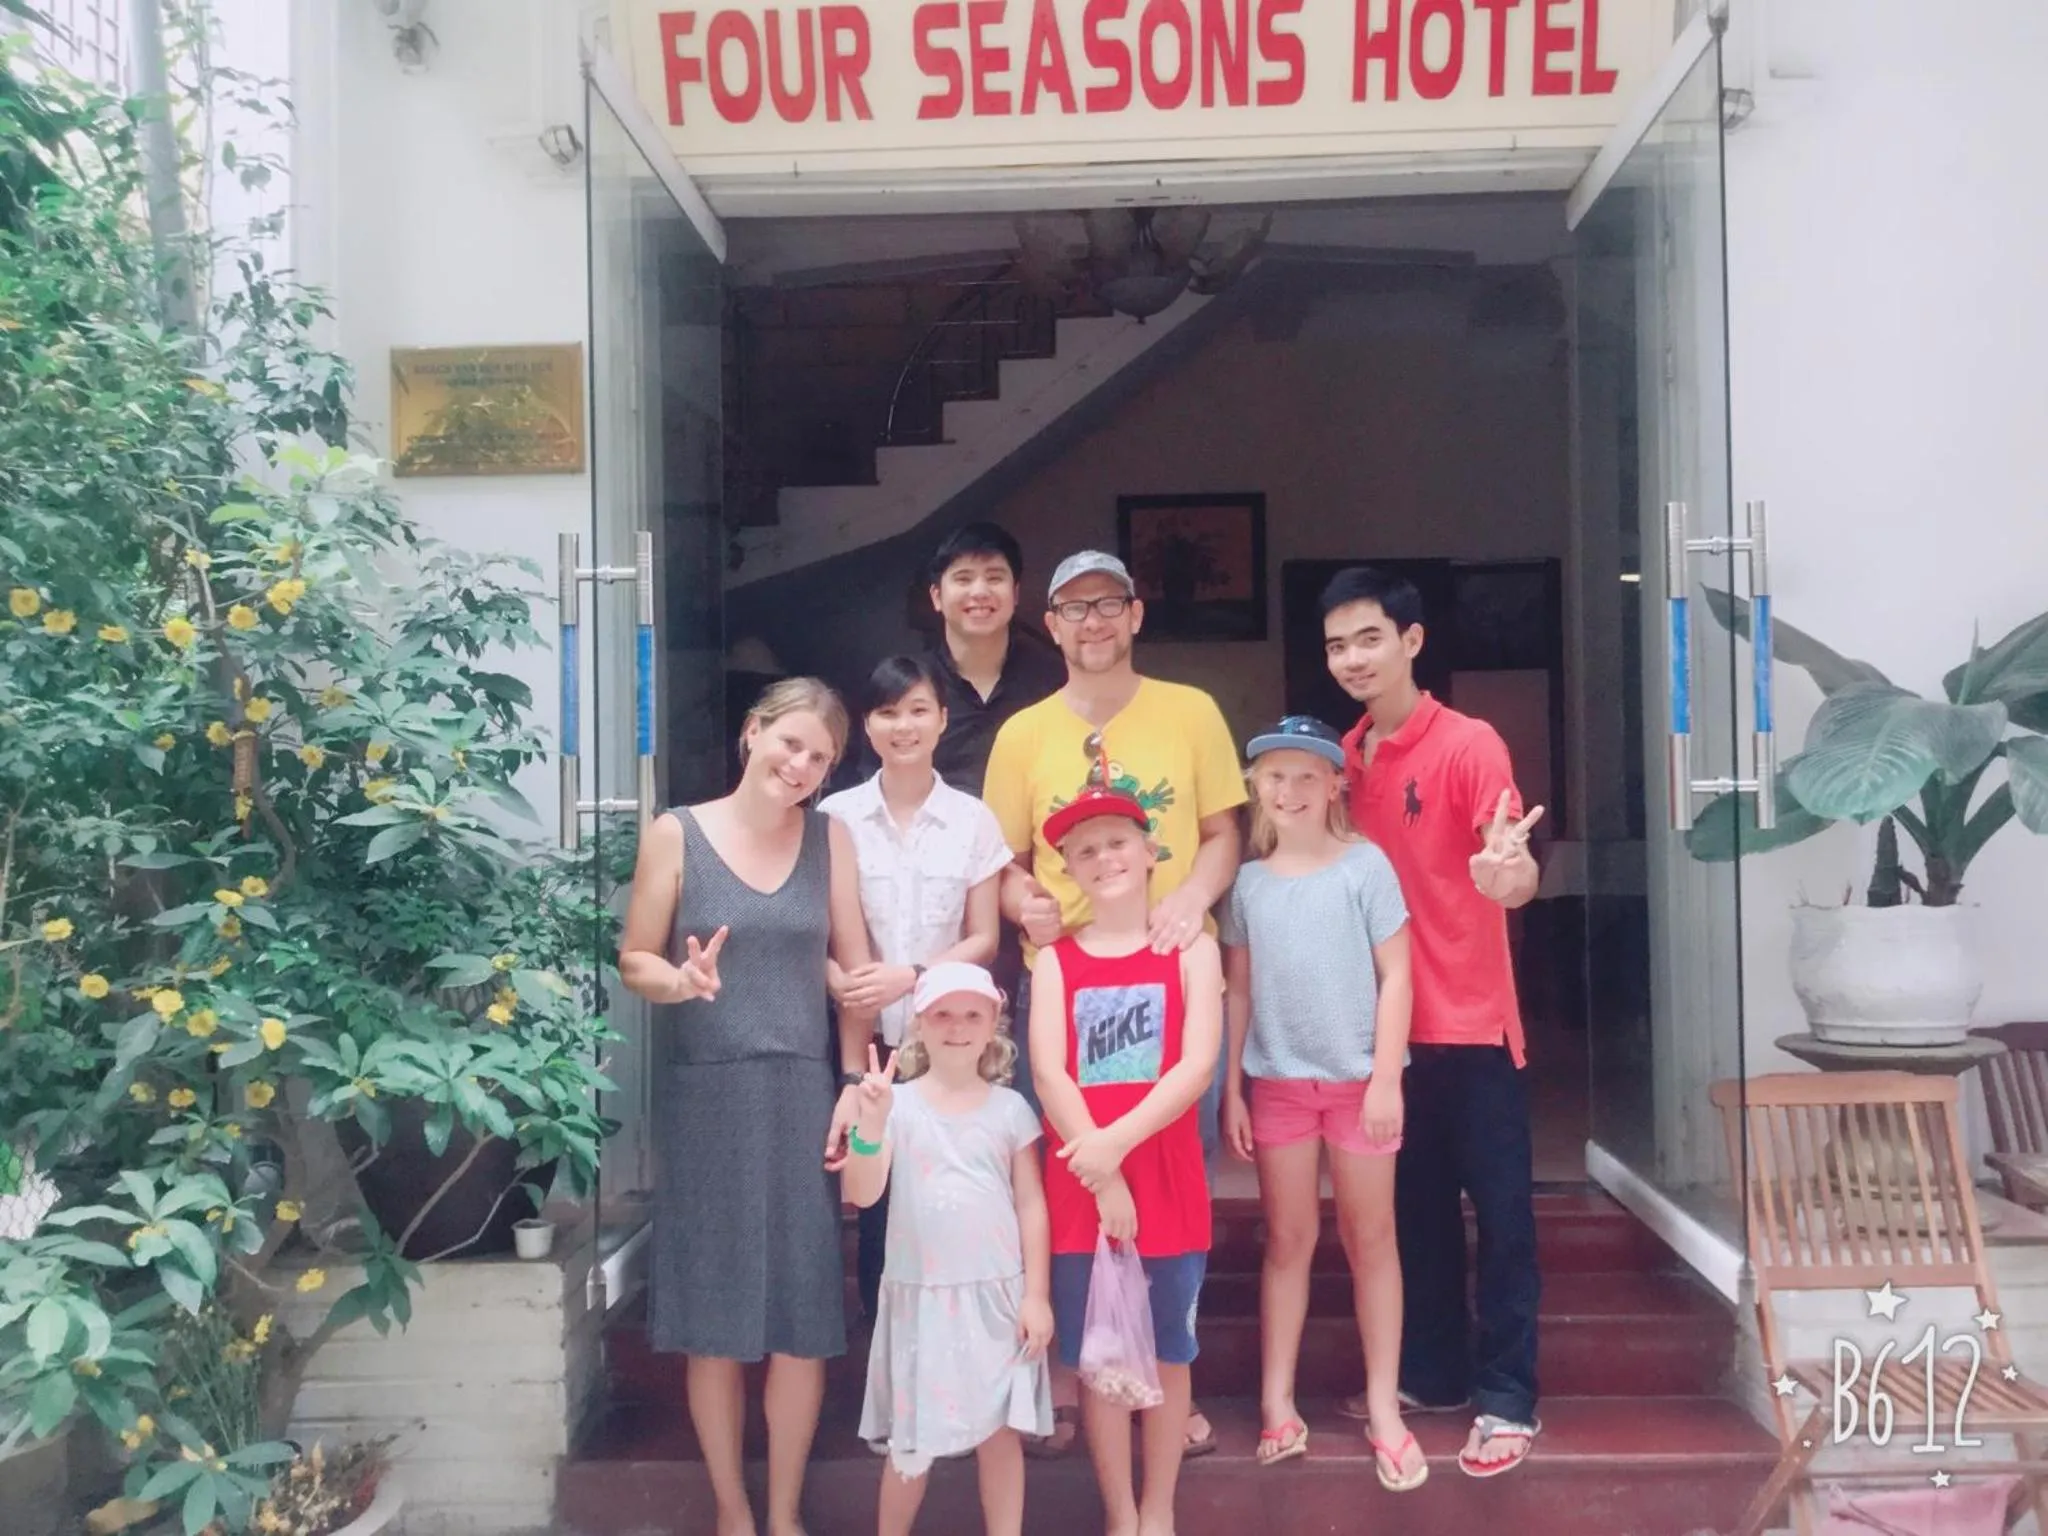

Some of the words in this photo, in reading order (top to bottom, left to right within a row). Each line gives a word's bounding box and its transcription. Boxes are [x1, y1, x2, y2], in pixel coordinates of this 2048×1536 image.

[661, 5, 872, 124] FOUR
[912, 0, 1306, 121] SEASONS
[1351, 0, 1619, 103] HOTEL
[1086, 1000, 1153, 1066] NIKE
